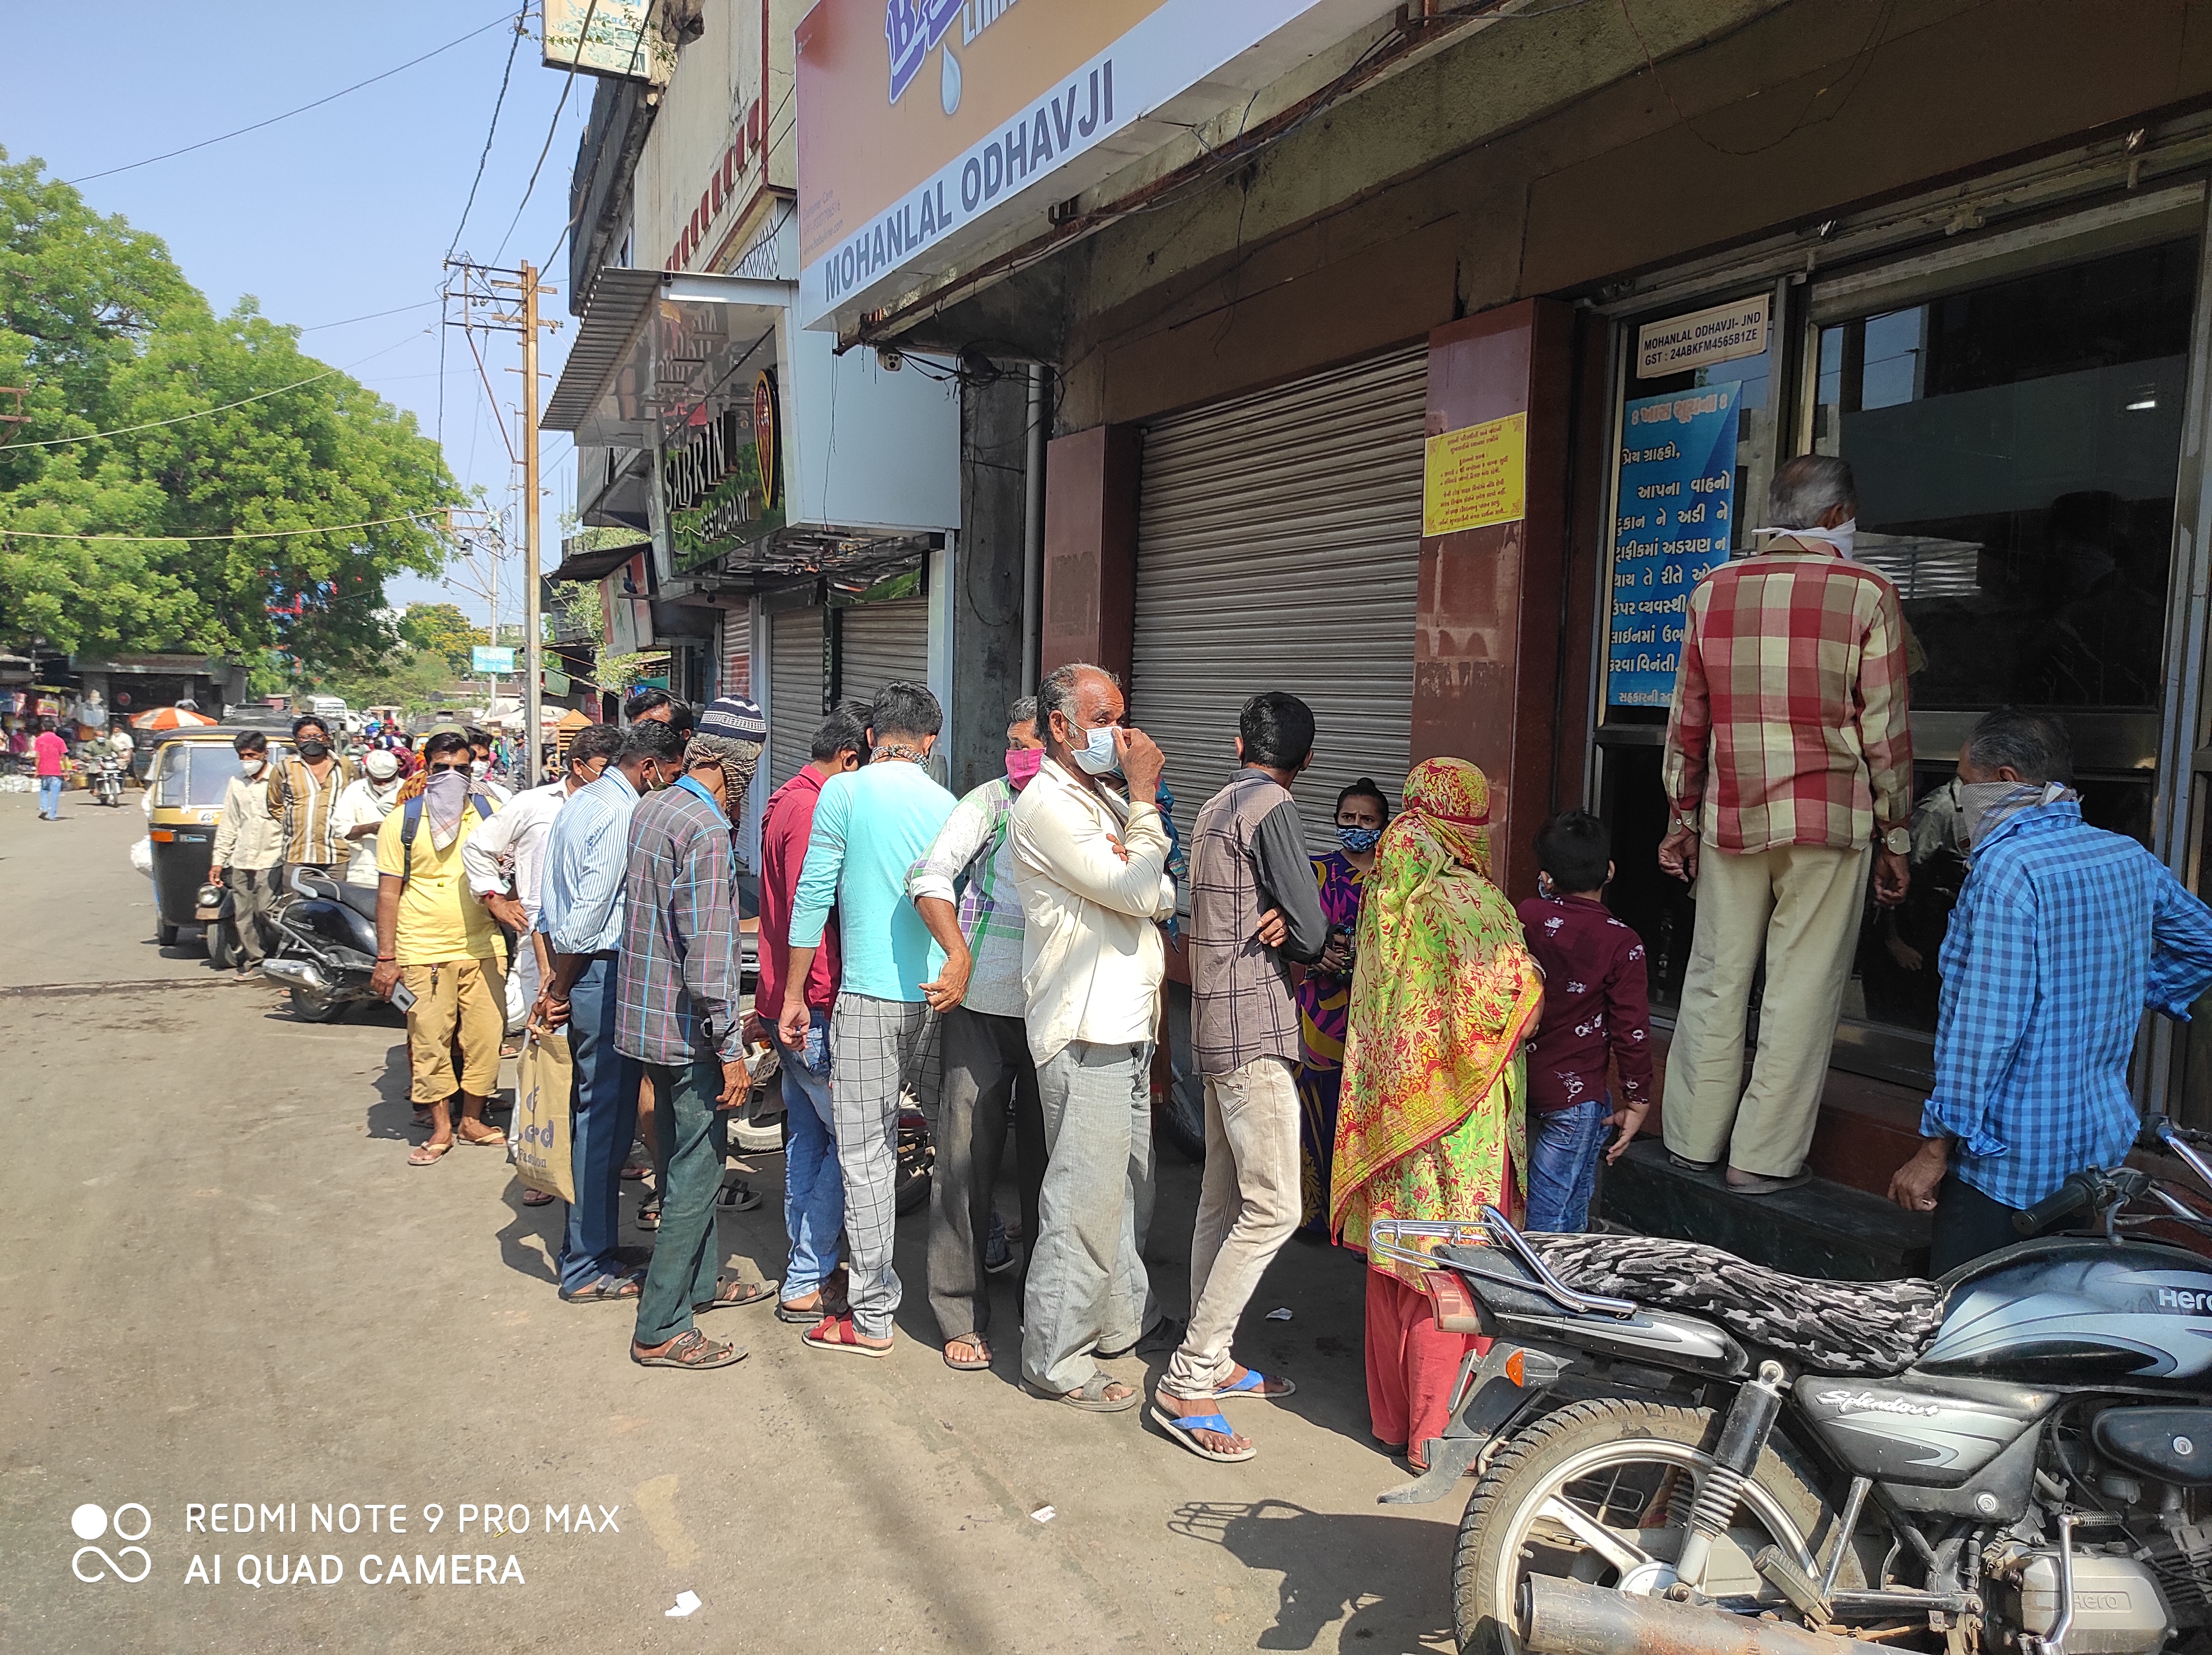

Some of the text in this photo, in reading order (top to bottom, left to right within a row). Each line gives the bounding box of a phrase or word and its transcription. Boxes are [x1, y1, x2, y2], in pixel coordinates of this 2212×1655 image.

[825, 59, 1113, 304] MOHANLAL ODHAVJI
[1643, 312, 1761, 352] MOHANLAL ODHAVJI- JND
[1645, 352, 1662, 366] GST
[1670, 328, 1758, 360] 24ABKFM4565B1ZE
[1643, 440, 1681, 462] ગ્રાહકો,
[1637, 470, 1731, 499] આપના વાહનો
[701, 490, 749, 544] RESTAURANT
[1656, 507, 1667, 526] ને
[1677, 502, 1706, 524] અડી
[1716, 501, 1729, 520] ને
[1662, 538, 1711, 555] અડચણ
[1715, 537, 1726, 551] ન
[1643, 566, 1653, 586] તે
[1661, 564, 1683, 585] રીતે
[1618, 689, 1658, 704] સહકારની
